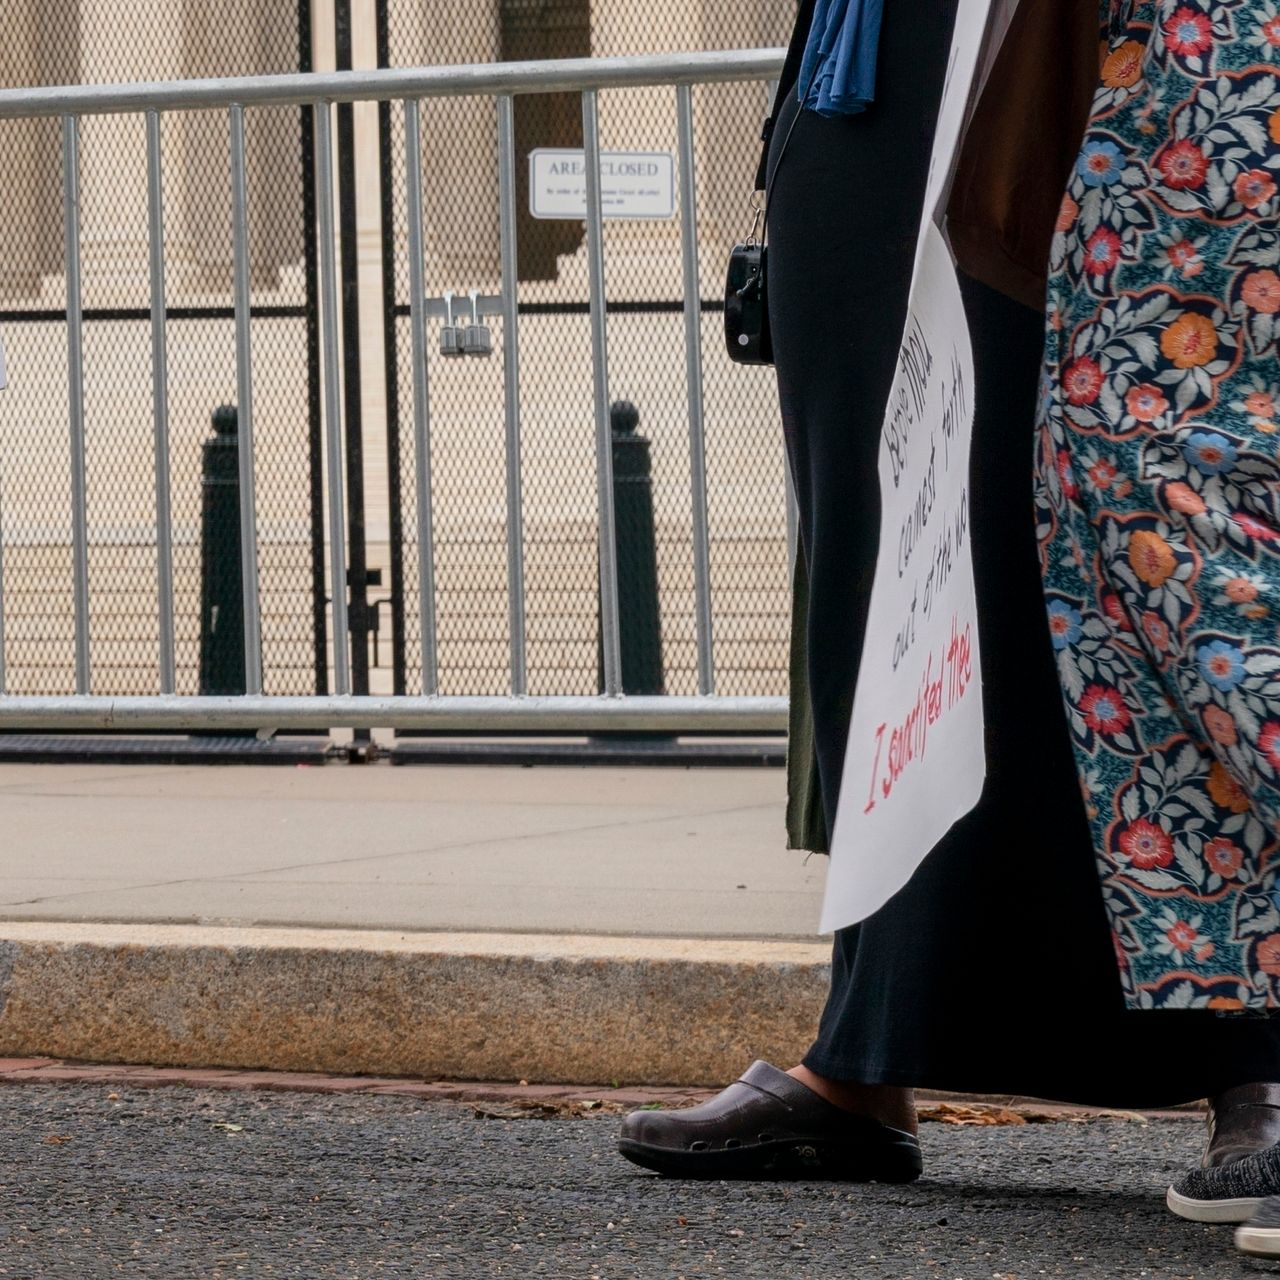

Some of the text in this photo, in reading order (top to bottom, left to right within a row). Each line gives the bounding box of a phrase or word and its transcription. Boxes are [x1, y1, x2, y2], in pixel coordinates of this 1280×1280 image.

[893, 577, 918, 672] out
[923, 544, 937, 623] of
[936, 511, 952, 593] the
[864, 722, 887, 815] I
[947, 610, 972, 711] thee
